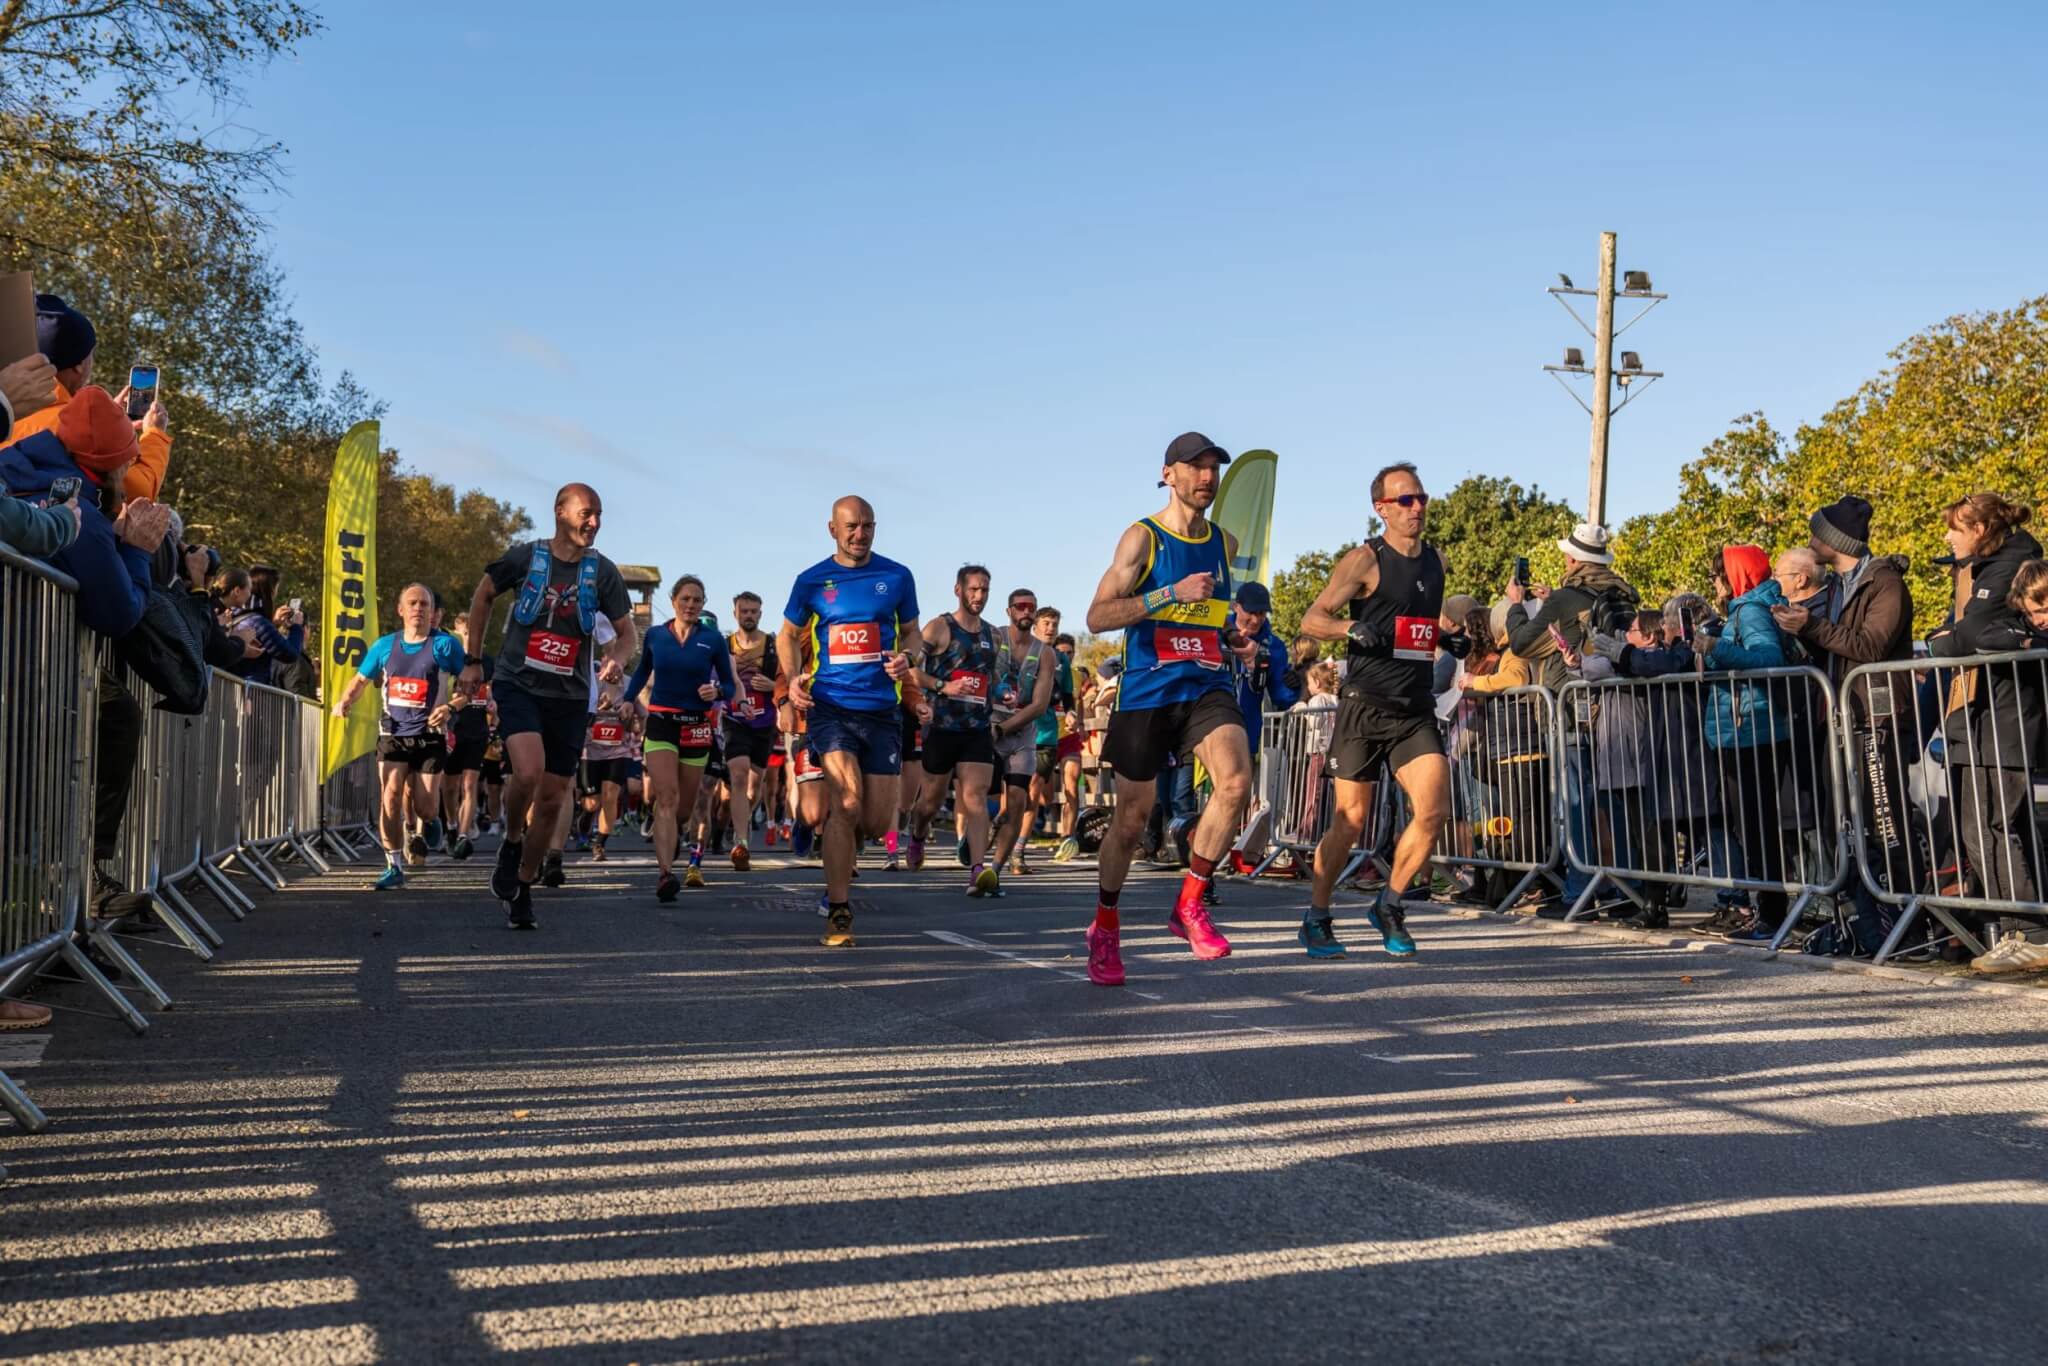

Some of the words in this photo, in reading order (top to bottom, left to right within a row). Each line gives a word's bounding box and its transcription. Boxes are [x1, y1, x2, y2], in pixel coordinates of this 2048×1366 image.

[332, 528, 368, 667] Start
[840, 629, 868, 644] 102
[1409, 624, 1433, 640] 176
[539, 639, 571, 657] 225
[1170, 636, 1204, 652] 183
[600, 727, 617, 736] 177
